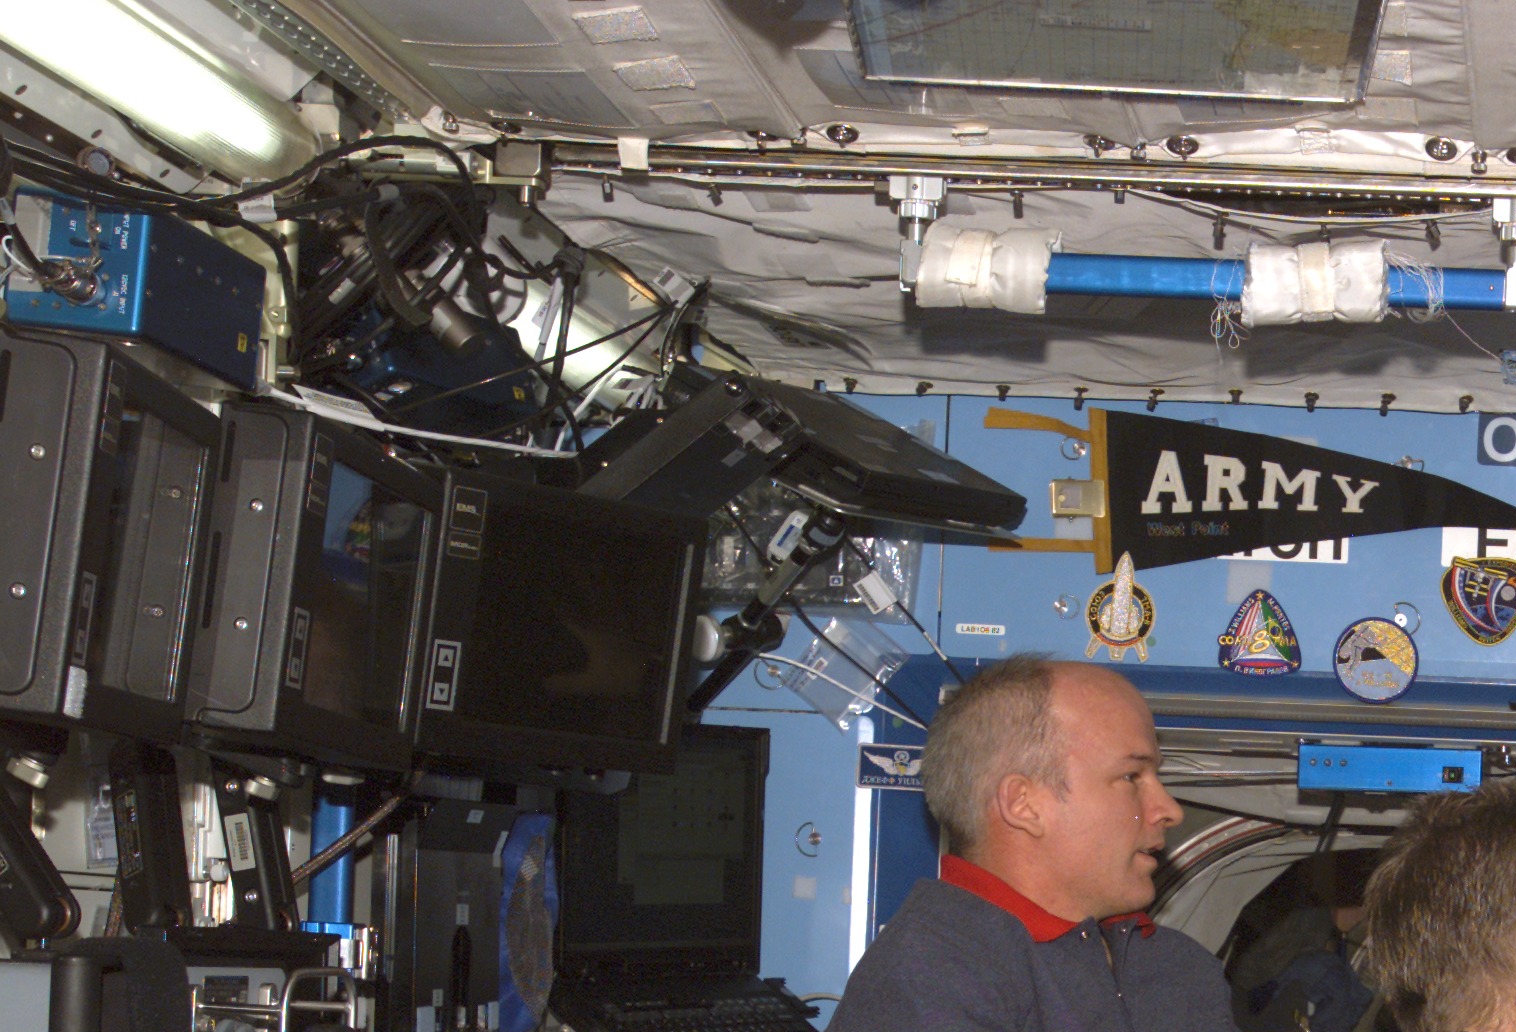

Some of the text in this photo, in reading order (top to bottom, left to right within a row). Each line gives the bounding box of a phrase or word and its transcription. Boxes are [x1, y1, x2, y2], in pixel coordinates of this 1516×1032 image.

[1141, 450, 1380, 514] ARMY
[1147, 521, 1230, 536] West Point
